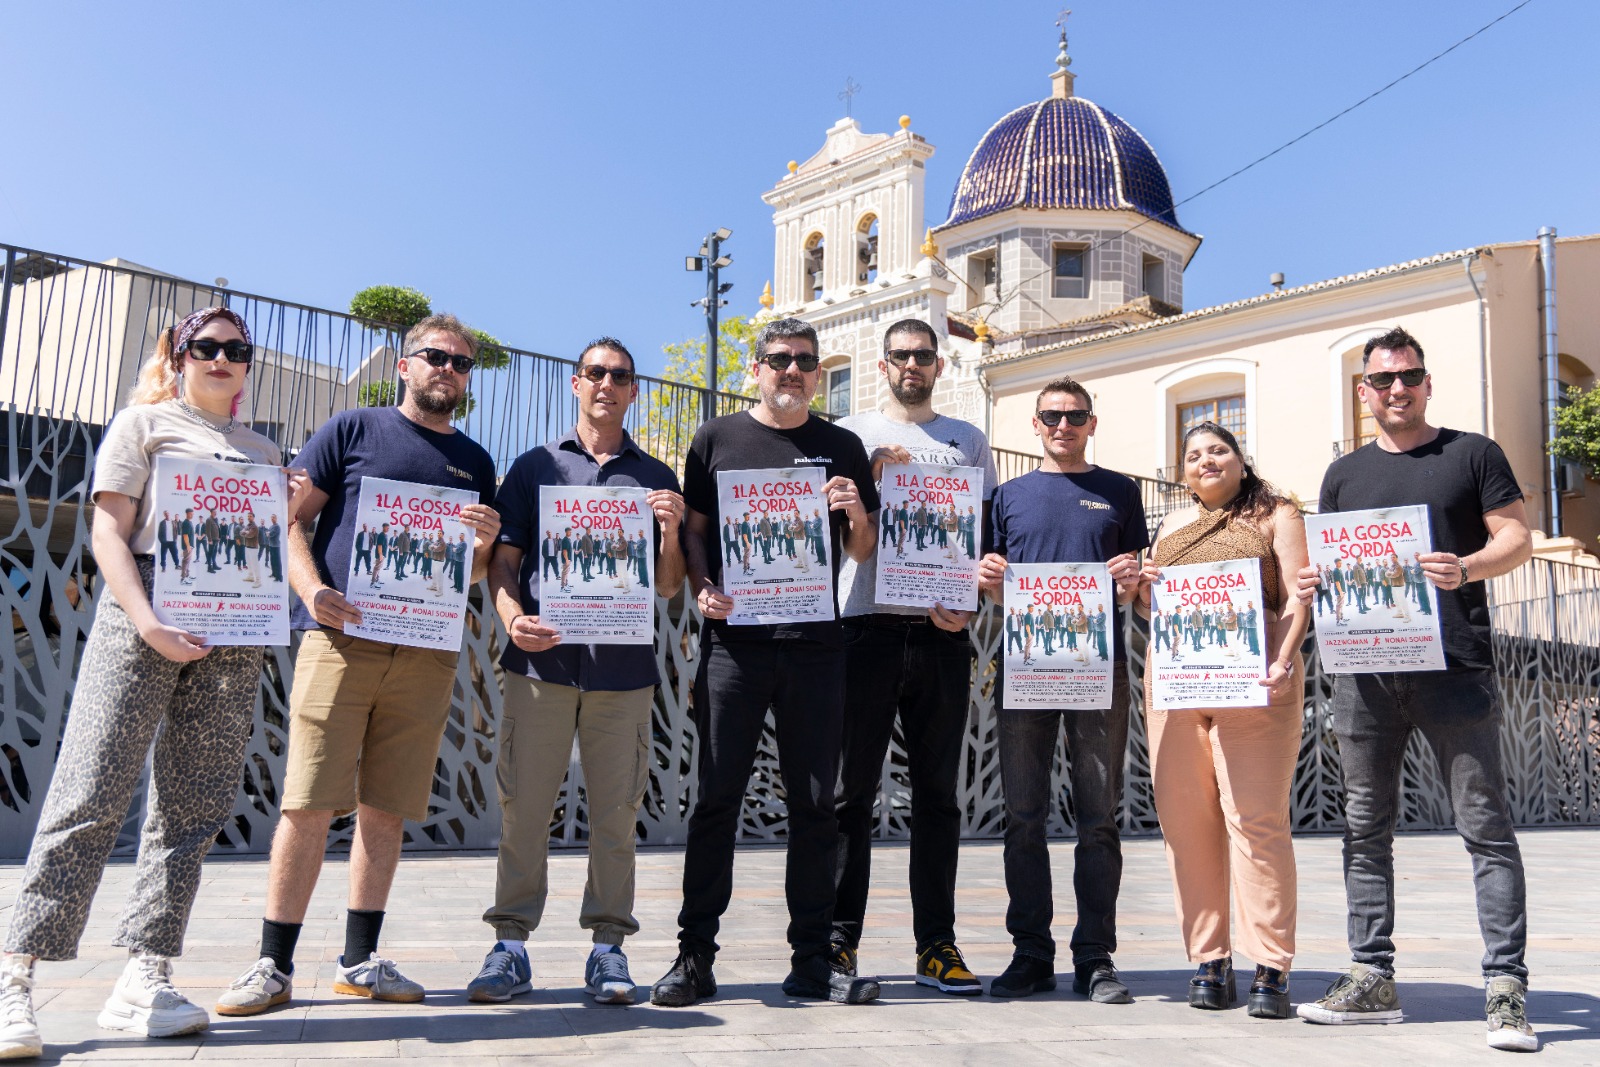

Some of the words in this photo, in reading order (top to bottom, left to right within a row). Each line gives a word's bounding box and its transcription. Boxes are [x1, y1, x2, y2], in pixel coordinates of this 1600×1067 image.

[212, 477, 272, 497] GOSSA
[762, 481, 813, 496] GOSSA
[923, 475, 970, 492] GOSSA
[193, 494, 253, 513] SORDA
[908, 490, 955, 505] SORDA
[408, 498, 463, 518] GOSSA
[587, 500, 639, 515] GOSSA
[748, 498, 799, 513] SORDA
[390, 511, 443, 531] SORDA
[571, 515, 623, 530] SORDA
[1354, 521, 1413, 541] GOSSA
[1339, 540, 1396, 560] SORDA
[1048, 576, 1098, 591] GOSSA
[1195, 573, 1246, 590] GOSSA
[731, 588, 771, 596] JAZZWOMAN
[1033, 591, 1083, 606] SORDA
[1181, 590, 1232, 607] SORDA
[162, 601, 212, 609] JAZZWOMAN
[256, 603, 282, 611] SOUND
[353, 600, 397, 612] JAZZWOMAN
[436, 611, 459, 619] SOUND
[1325, 638, 1369, 646] JAZZWOMAN
[1158, 673, 1200, 681] JAZZWOMAN
